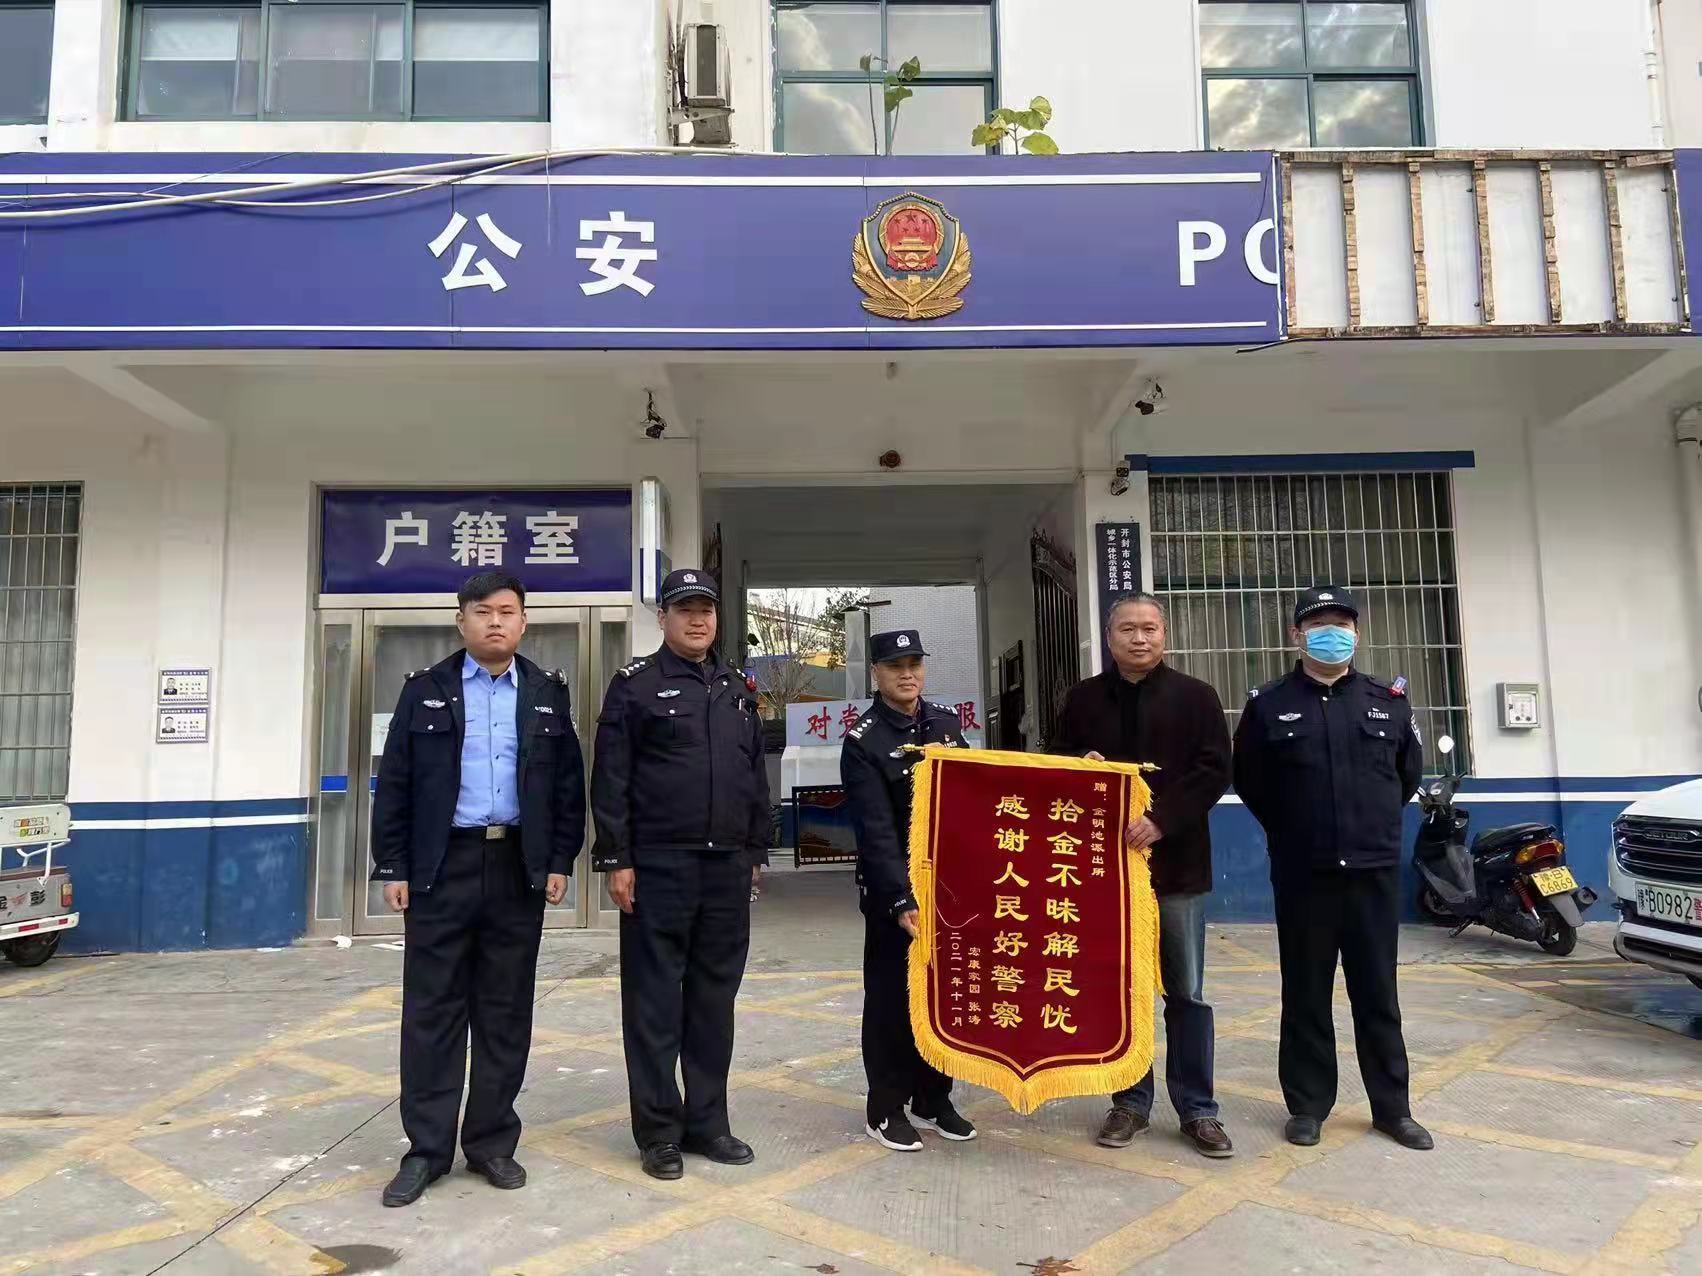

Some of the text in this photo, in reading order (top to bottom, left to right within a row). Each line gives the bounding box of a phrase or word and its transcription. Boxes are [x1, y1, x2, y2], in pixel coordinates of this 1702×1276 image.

[427, 210, 658, 297] 公安
[376, 510, 579, 566] 户籍室
[1120, 528, 1133, 591] 开封市公安局
[989, 794, 1031, 1029] 感谢人民好警察
[1040, 798, 1085, 1034] 拾金不昧解民忧
